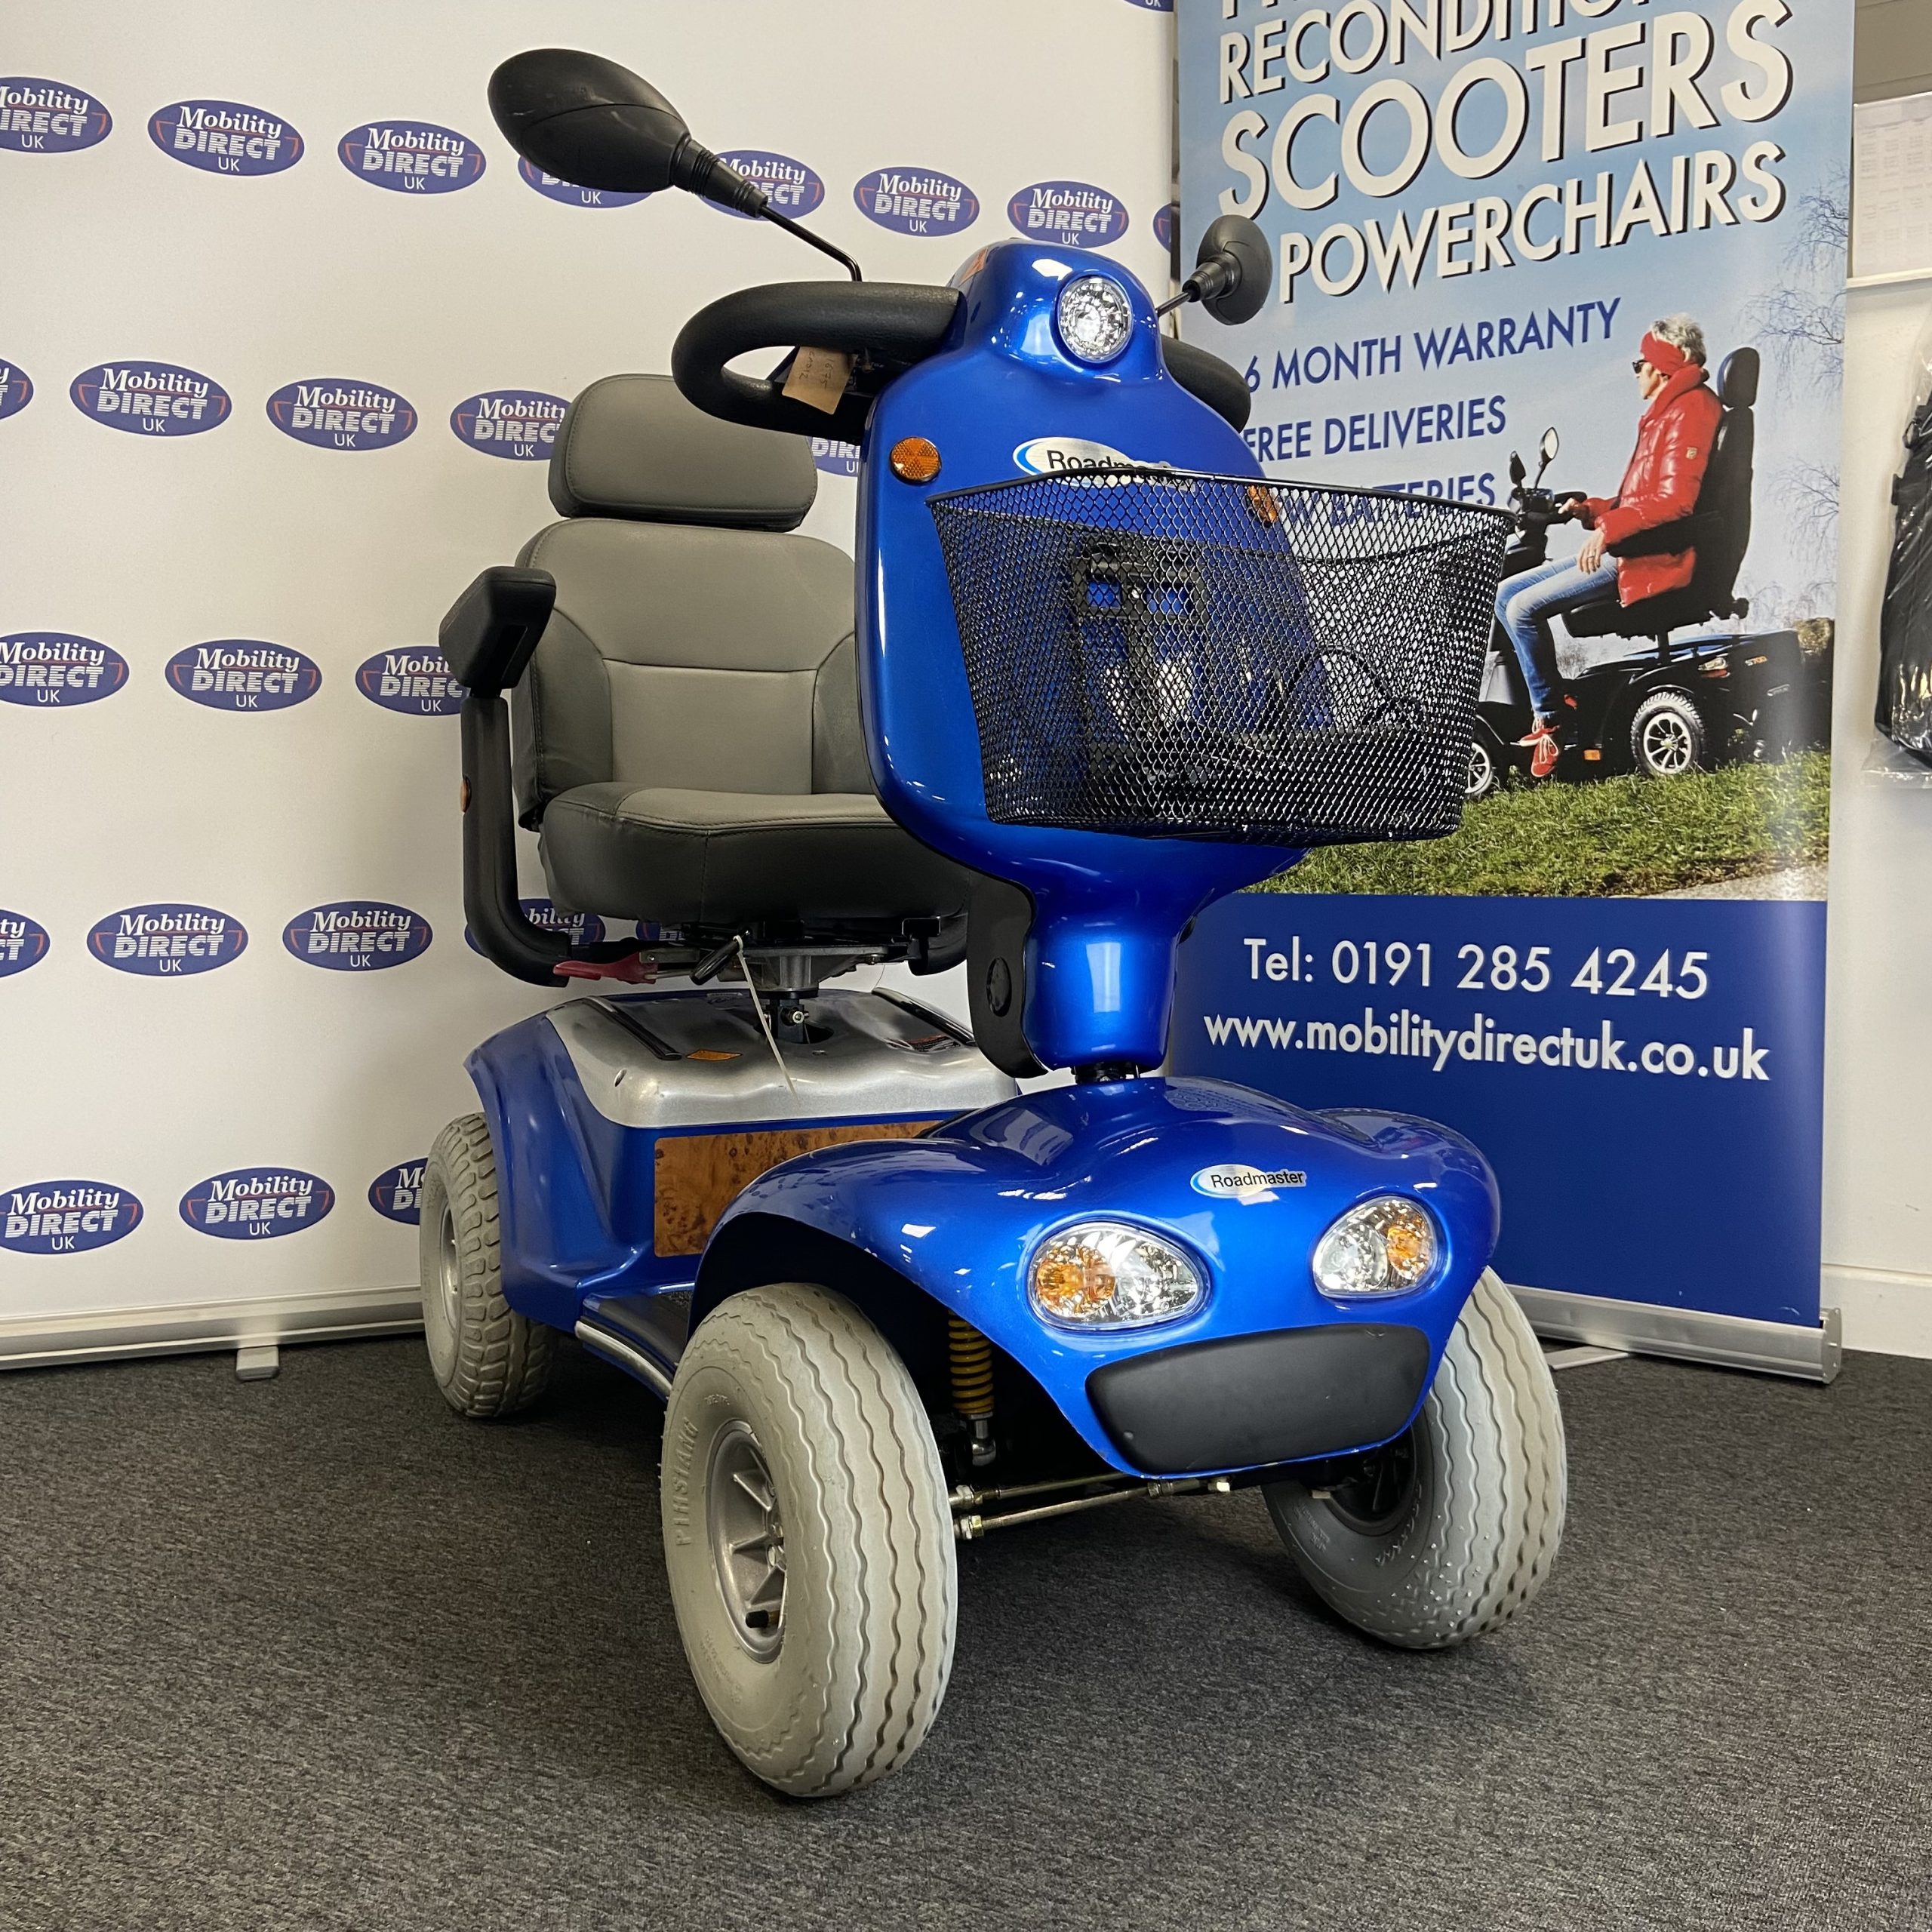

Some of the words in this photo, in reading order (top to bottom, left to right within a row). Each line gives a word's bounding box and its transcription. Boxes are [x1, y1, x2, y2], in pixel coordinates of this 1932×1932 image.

[1219, 0, 1792, 220] SCOOTERS
[0, 109, 88, 136] IRECT
[177, 106, 282, 139] Mobility
[22, 134, 44, 149] UK
[174, 128, 281, 160] DIRECT
[365, 128, 465, 156] Mobility
[218, 157, 240, 171] UK
[362, 149, 464, 177] DIRECT
[405, 176, 425, 190] UK
[876, 174, 961, 202] Mobility
[582, 191, 601, 204] UK
[874, 194, 960, 221] DIRECT
[1029, 188, 1112, 214] Mobility
[909, 220, 927, 233] UK
[1027, 208, 1112, 233] DIRECT
[1278, 140, 1786, 304] POWERCHAIRS
[1062, 232, 1079, 245] UK
[1244, 354, 1261, 393] 6
[1272, 333, 1402, 389] MONTH
[1413, 297, 1621, 369] WARRANTY
[99, 368, 208, 398] Mobility
[97, 390, 208, 420] DIRECT
[294, 385, 395, 413] Mobility
[143, 418, 165, 432] UK
[291, 408, 395, 434] DIRECT
[474, 419, 560, 443] DIREC
[1244, 420, 1312, 462] FREE
[1324, 395, 1506, 455] DELIVERIES
[334, 433, 355, 447] UK
[514, 444, 534, 457] UK
[0, 641, 105, 666] Mobility
[194, 648, 300, 672] Mobility
[382, 654, 451, 675] Mobil
[191, 669, 298, 694] DIRECT
[380, 675, 463, 698] DIREC
[37, 689, 60, 703] UK
[235, 694, 258, 708] UK
[420, 699, 441, 712] UK
[116, 913, 226, 936] Mobility
[310, 910, 411, 932] Mobility
[114, 934, 224, 958] DIRECT
[307, 931, 410, 953] DIRECT
[159, 958, 183, 973] UK
[349, 955, 371, 967] UK
[1244, 936, 1314, 983] Tel:
[1331, 940, 1432, 987] 0191
[1457, 943, 1551, 993] 285
[1571, 947, 1709, 999] 4245
[1204, 1007, 1771, 1081] www.mobilitydirectuk.co.uk
[208, 1176, 312, 1201] Mobility
[1211, 1169, 1304, 1189] Roadmaster
[7, 1189, 119, 1215] Mobility
[205, 1195, 312, 1223] DIRECT
[5, 1209, 118, 1238] DIRECT
[249, 1222, 271, 1235] UK
[51, 1235, 75, 1250] UK
